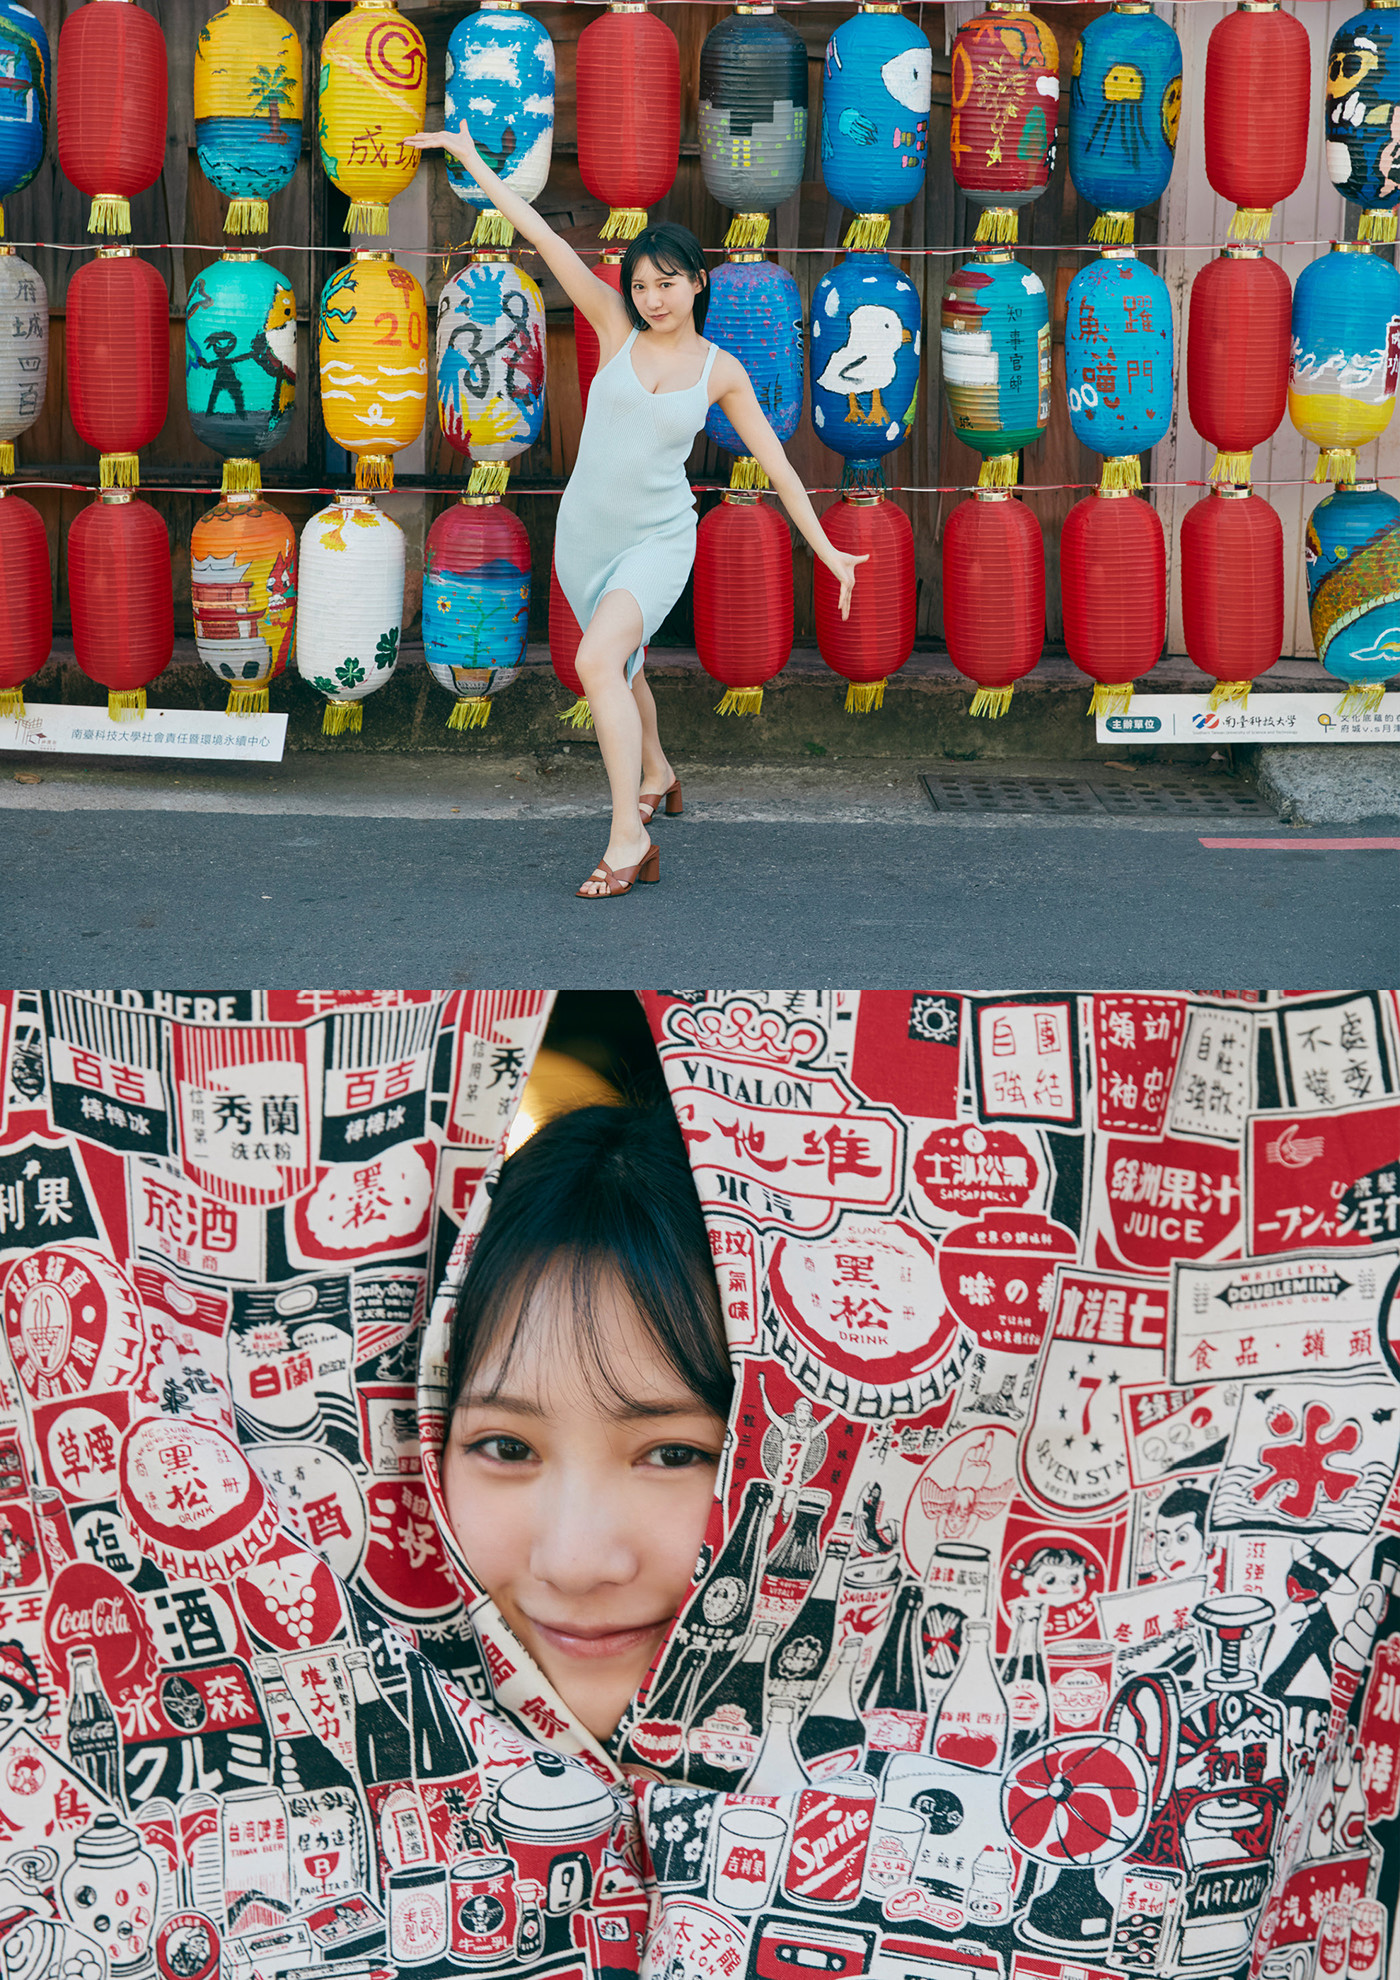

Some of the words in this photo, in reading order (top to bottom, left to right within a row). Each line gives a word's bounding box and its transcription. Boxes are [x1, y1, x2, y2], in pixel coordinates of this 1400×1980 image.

[12, 278, 44, 416] 府城四百
[1005, 304, 1025, 394] 知事官邸
[1112, 718, 1155, 731] 主辦單位
[153, 990, 237, 1023] HERE
[69, 1047, 146, 1103] 百吉
[345, 1059, 416, 1110] 百吉
[681, 1060, 813, 1110] VITALON
[213, 1094, 299, 1136] 秀蘭
[342, 1162, 393, 1230] 黑松
[1123, 1211, 1204, 1245] JUICE
[830, 1254, 893, 1330] 黑松
[1228, 1277, 1340, 1302] DOUBLEMINT
[839, 1330, 889, 1346] DRINK
[249, 1351, 313, 1399] 白蘭
[1078, 1376, 1102, 1436] 7
[158, 1443, 209, 1512] 黑松
[1036, 1438, 1078, 1486] SEVEN
[1086, 1452, 1128, 1486] STA
[178, 1504, 215, 1524] DRINK
[51, 1595, 132, 1644] Coca-Cola
[155, 1588, 227, 1661] 酒
[301, 1663, 341, 1741] 維大力
[313, 1857, 331, 1877] B
[792, 1809, 870, 1876] Sprite
